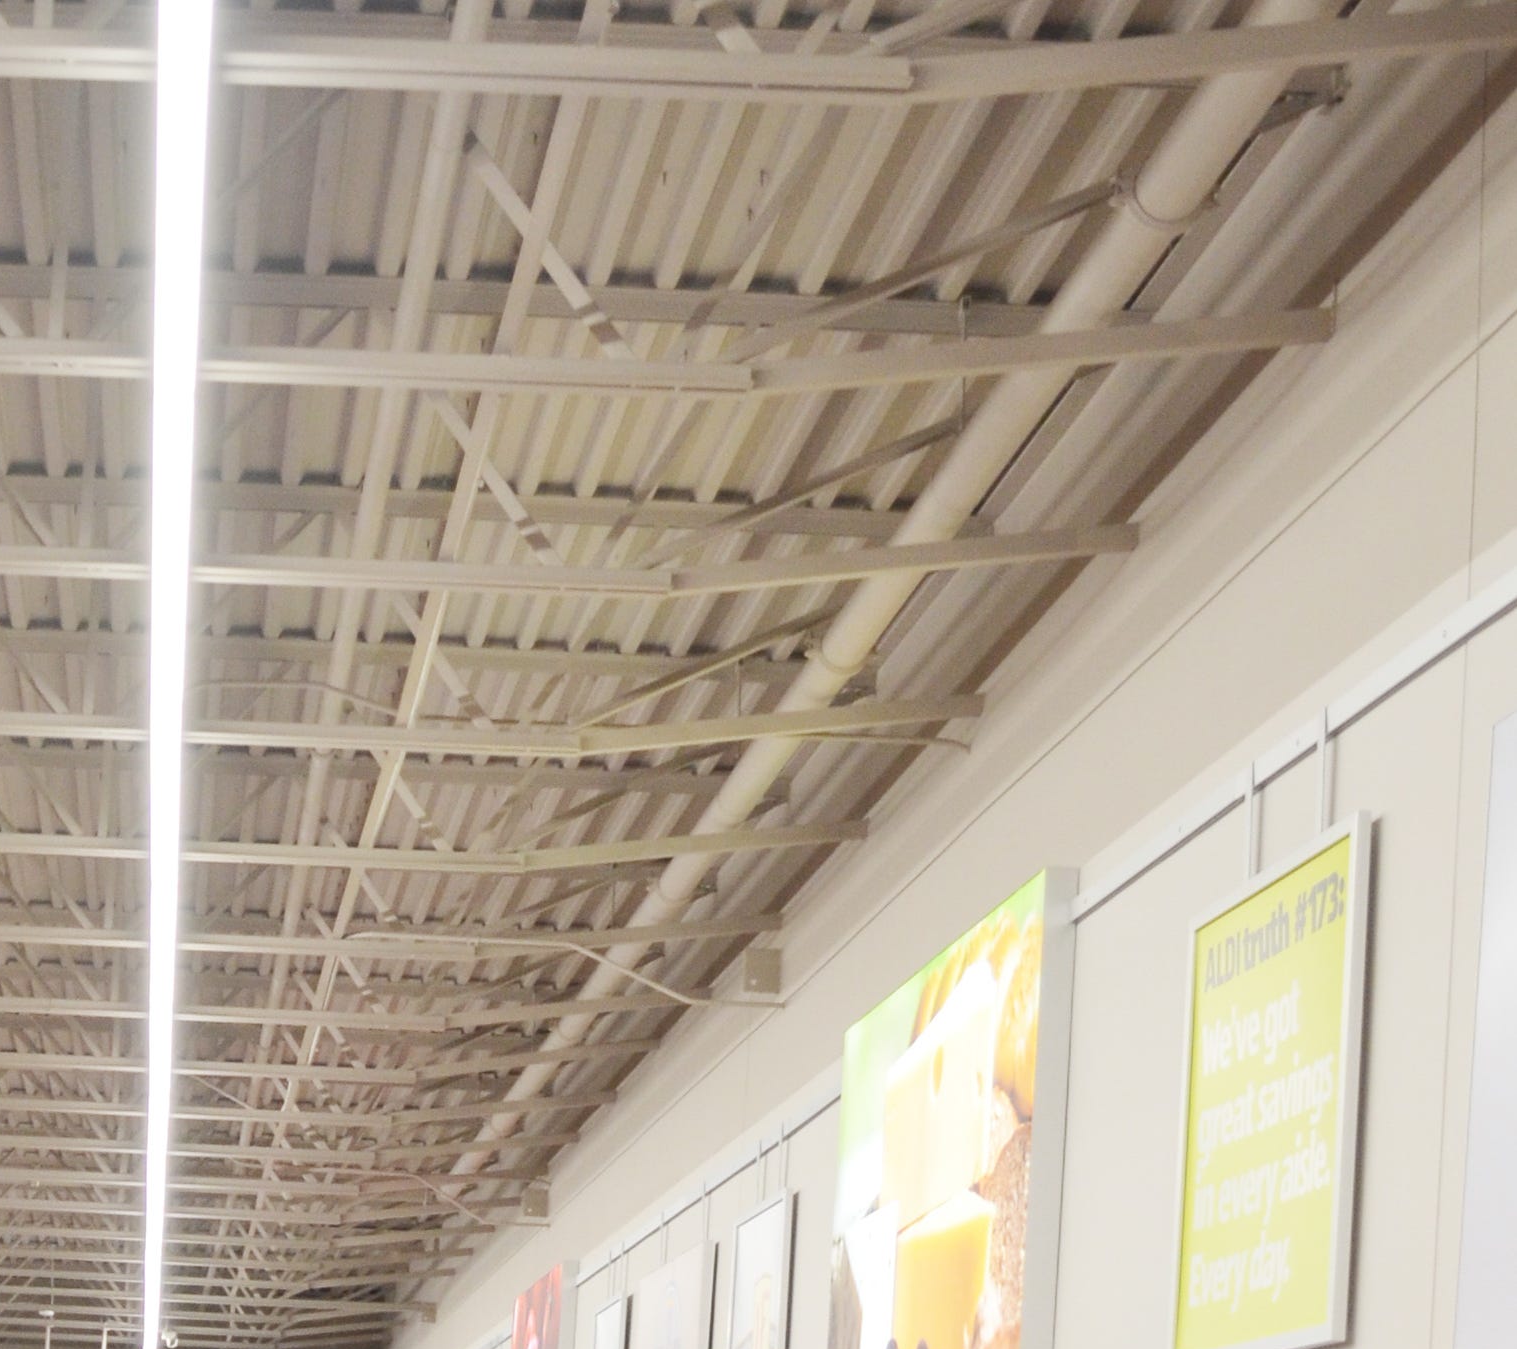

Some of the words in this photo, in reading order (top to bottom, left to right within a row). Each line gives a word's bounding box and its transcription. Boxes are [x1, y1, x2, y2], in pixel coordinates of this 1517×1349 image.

[1204, 928, 1239, 993] ALDI
[1243, 902, 1289, 973] truth
[1294, 871, 1345, 943] #173:
[1201, 1008, 1258, 1078] We've
[1264, 978, 1300, 1064] got
[1196, 1078, 1255, 1183] great
[1258, 1052, 1334, 1125] savings
[1193, 1179, 1213, 1232] in
[1217, 1159, 1278, 1225] every
[1281, 1129, 1330, 1205] aisle.
[1188, 1246, 1245, 1312] Every
[1248, 1231, 1290, 1303] day.
